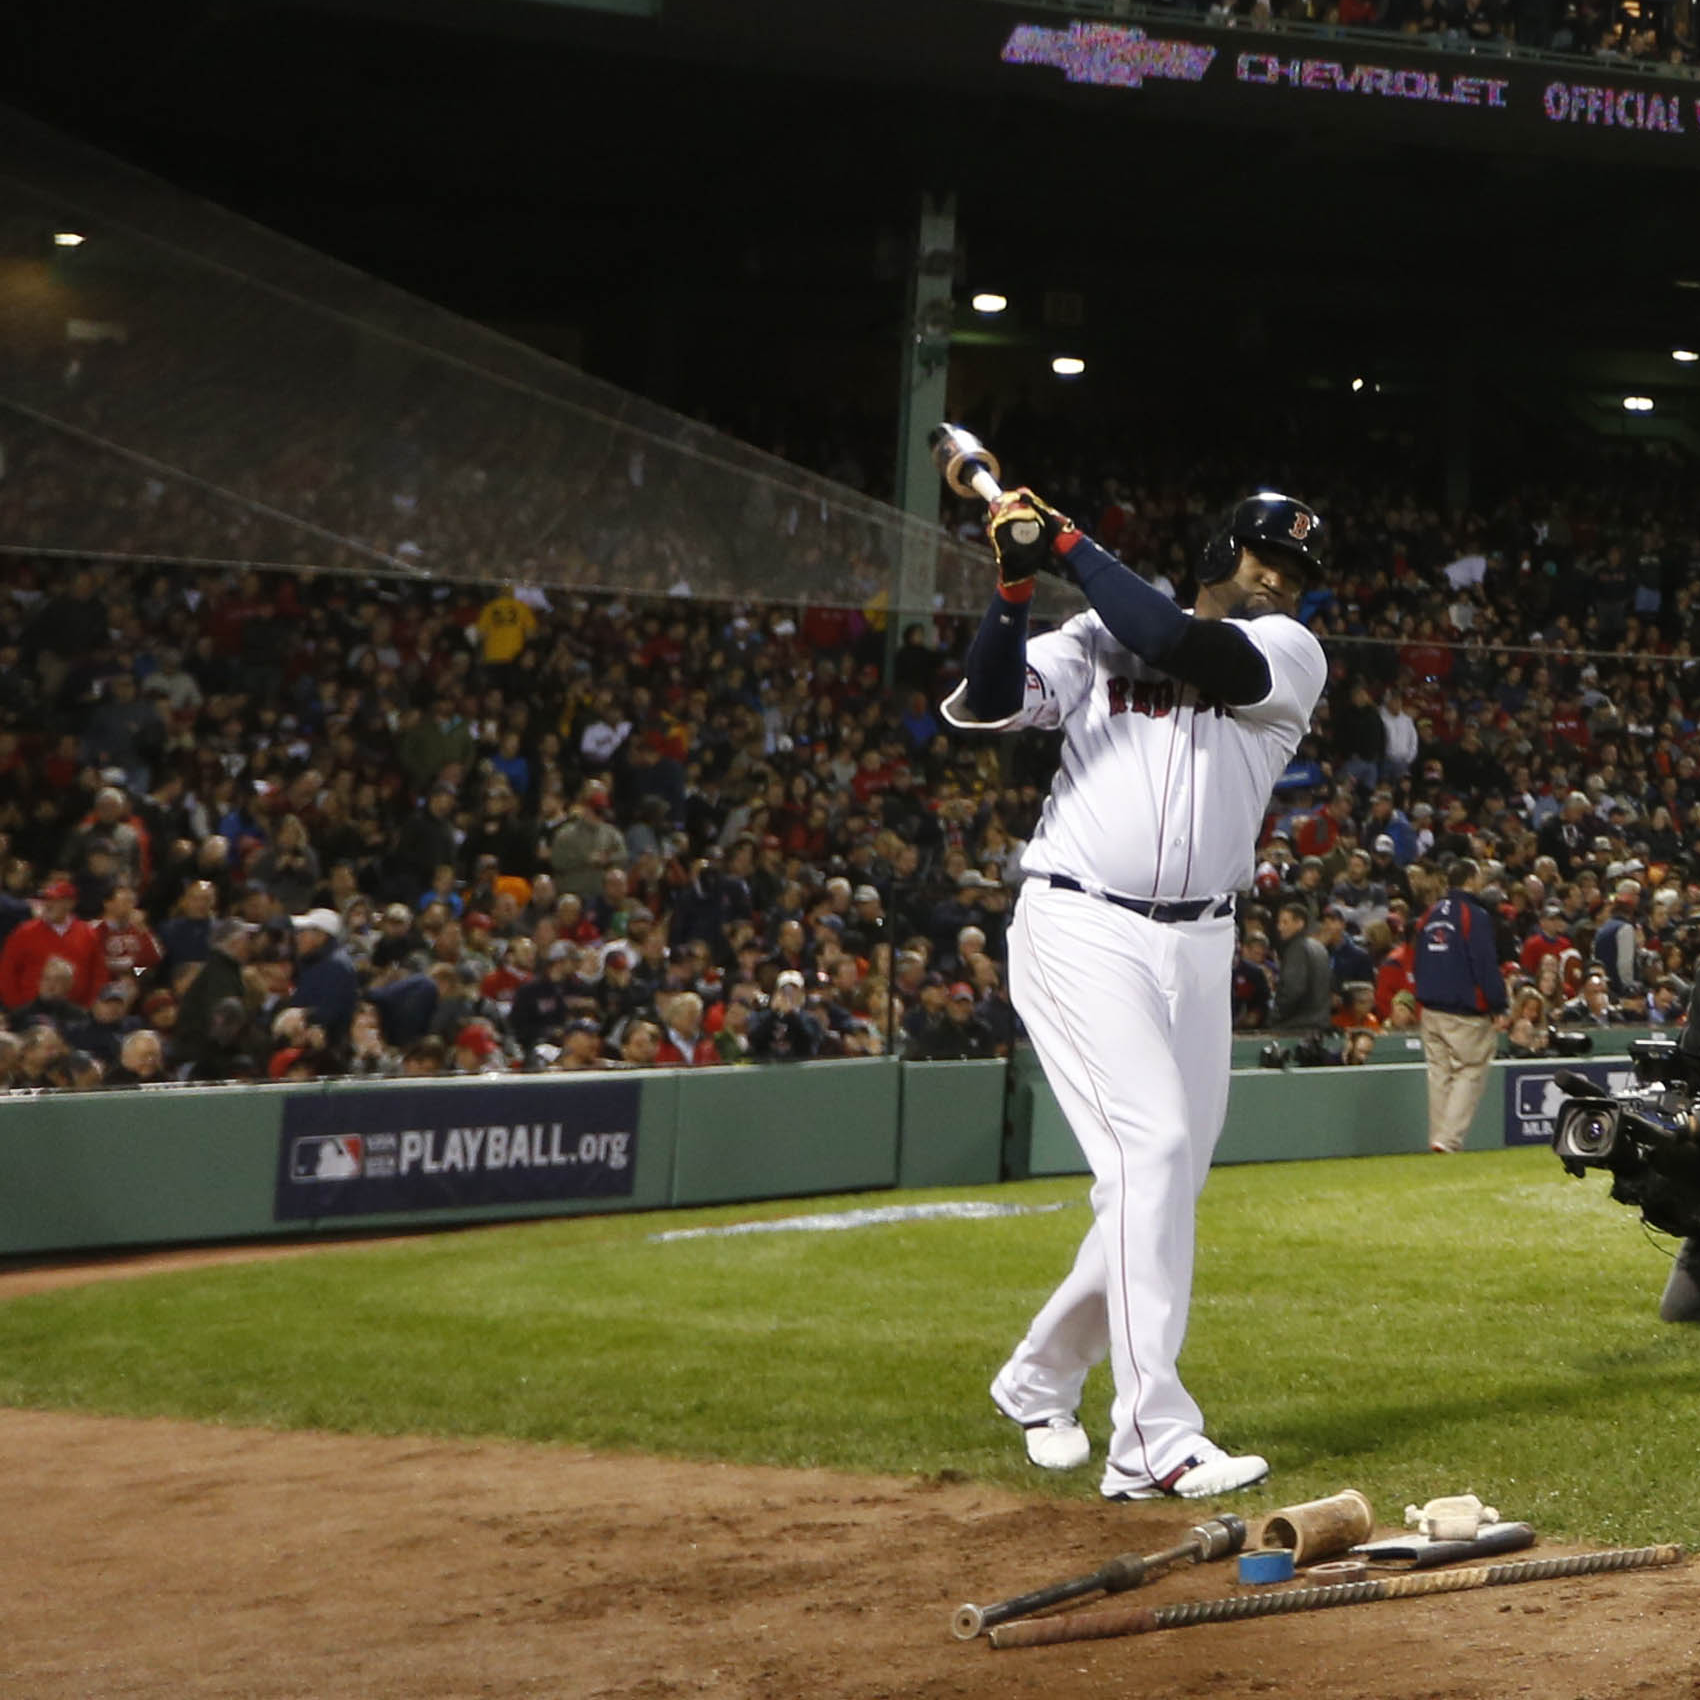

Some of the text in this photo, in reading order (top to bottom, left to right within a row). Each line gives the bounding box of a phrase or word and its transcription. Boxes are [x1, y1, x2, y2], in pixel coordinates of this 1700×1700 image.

[1236, 52, 1509, 107] CHEVROLET
[1543, 81, 1685, 134] OFFICIAL
[1289, 511, 1311, 540] B
[401, 1123, 631, 1176] PLAYBALL.org
